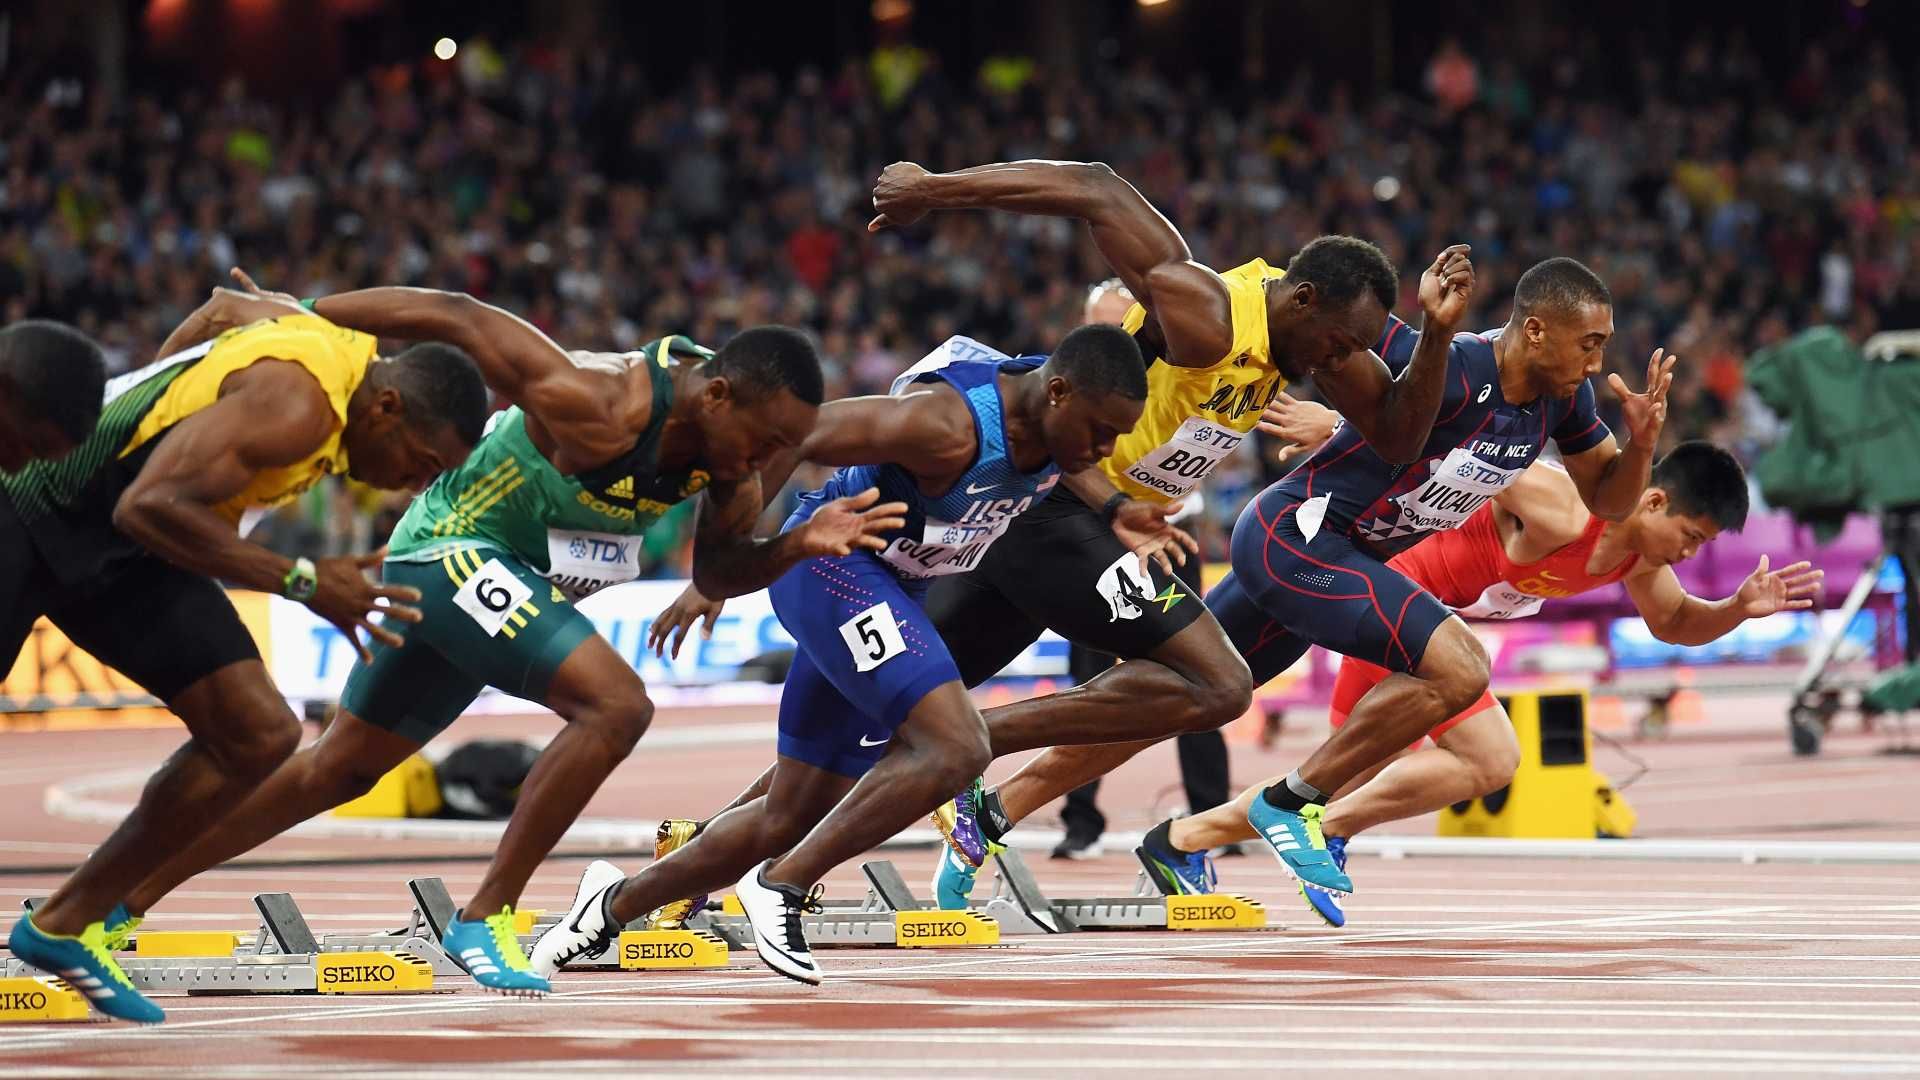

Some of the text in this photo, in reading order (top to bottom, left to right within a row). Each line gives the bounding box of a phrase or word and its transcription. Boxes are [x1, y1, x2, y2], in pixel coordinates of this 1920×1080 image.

[1210, 430, 1242, 449] TD
[1158, 449, 1216, 479] BOL
[1472, 466, 1512, 486] TDK
[588, 538, 629, 563] TDK
[475, 578, 512, 612] 6
[855, 615, 886, 661] 5
[1172, 906, 1237, 921] SEIKO
[902, 922, 967, 938] SEIKO
[625, 943, 694, 960] SEIKO
[323, 964, 395, 984] SEIKO
[0, 991, 47, 1010] IKO
